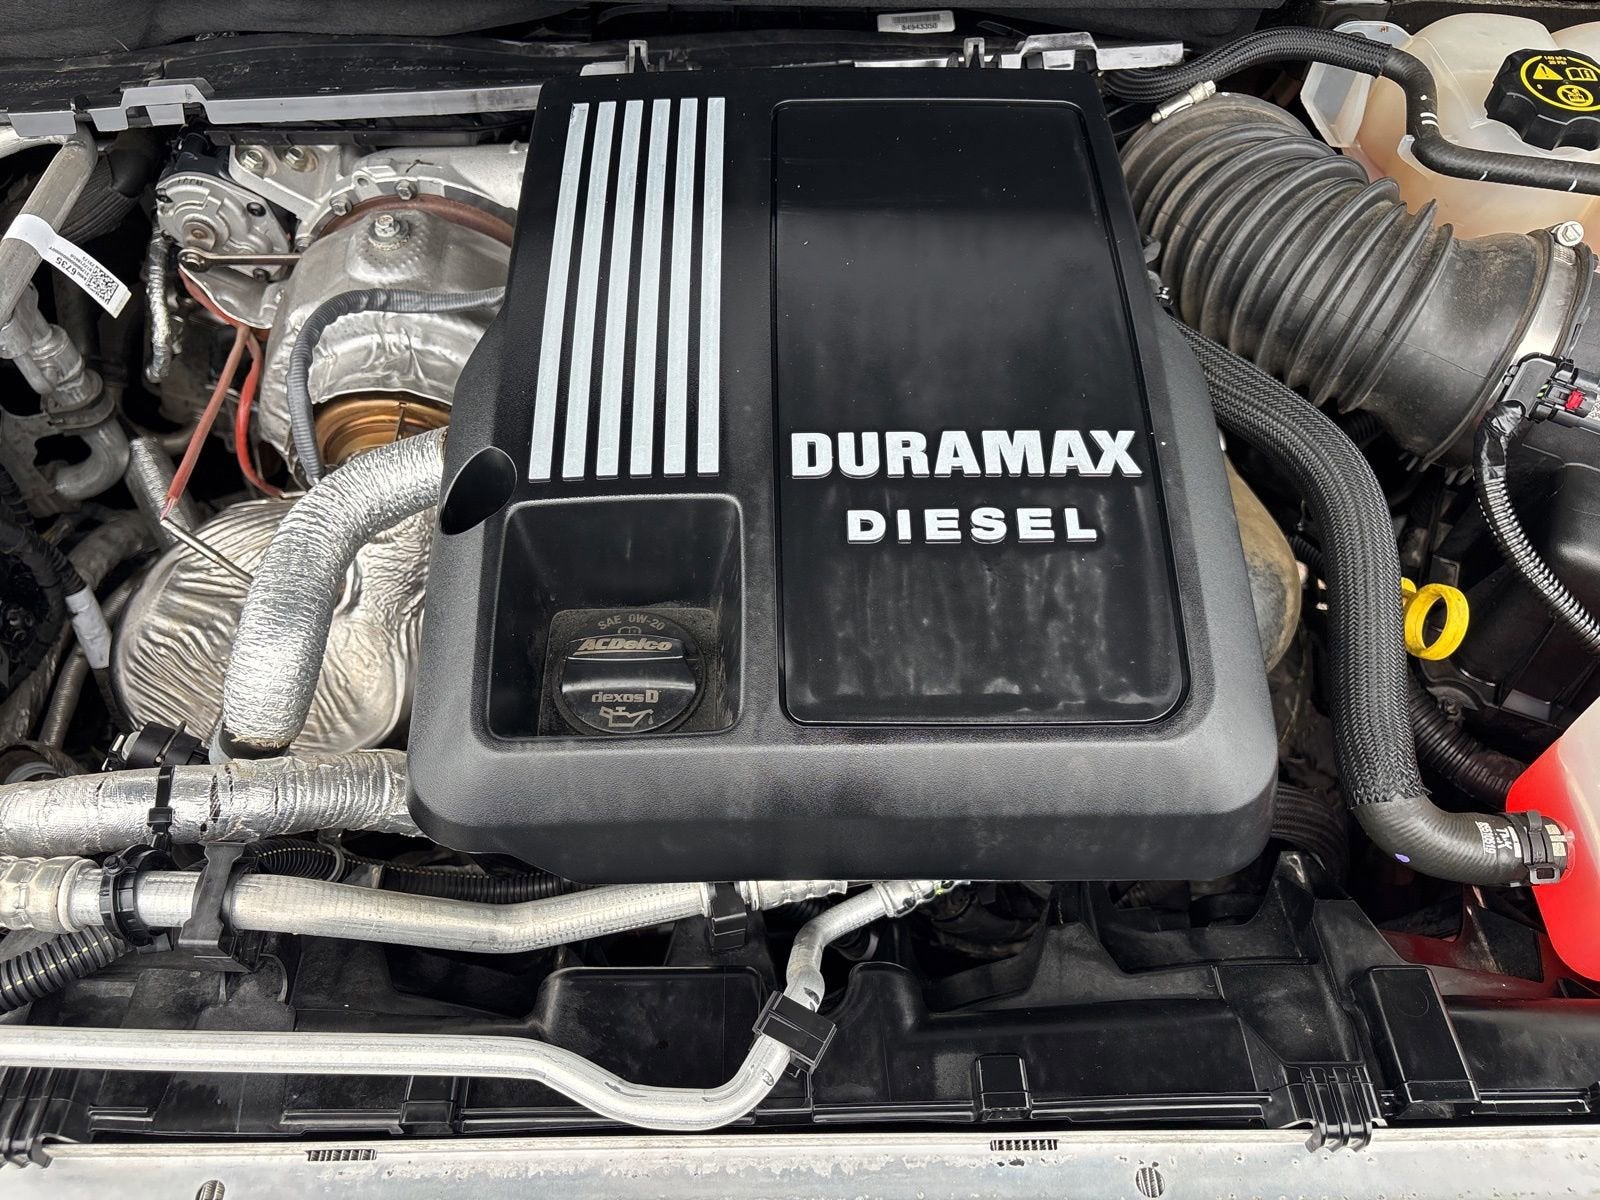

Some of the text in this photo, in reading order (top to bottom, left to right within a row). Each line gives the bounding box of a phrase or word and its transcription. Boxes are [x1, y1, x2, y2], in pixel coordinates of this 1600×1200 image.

[56, 257, 77, 277] 6735
[790, 430, 1142, 480] DURAMAX
[846, 506, 1098, 544] DIESEL
[597, 613, 666, 631] SAE 0W-20
[577, 638, 673, 652] ACDelco
